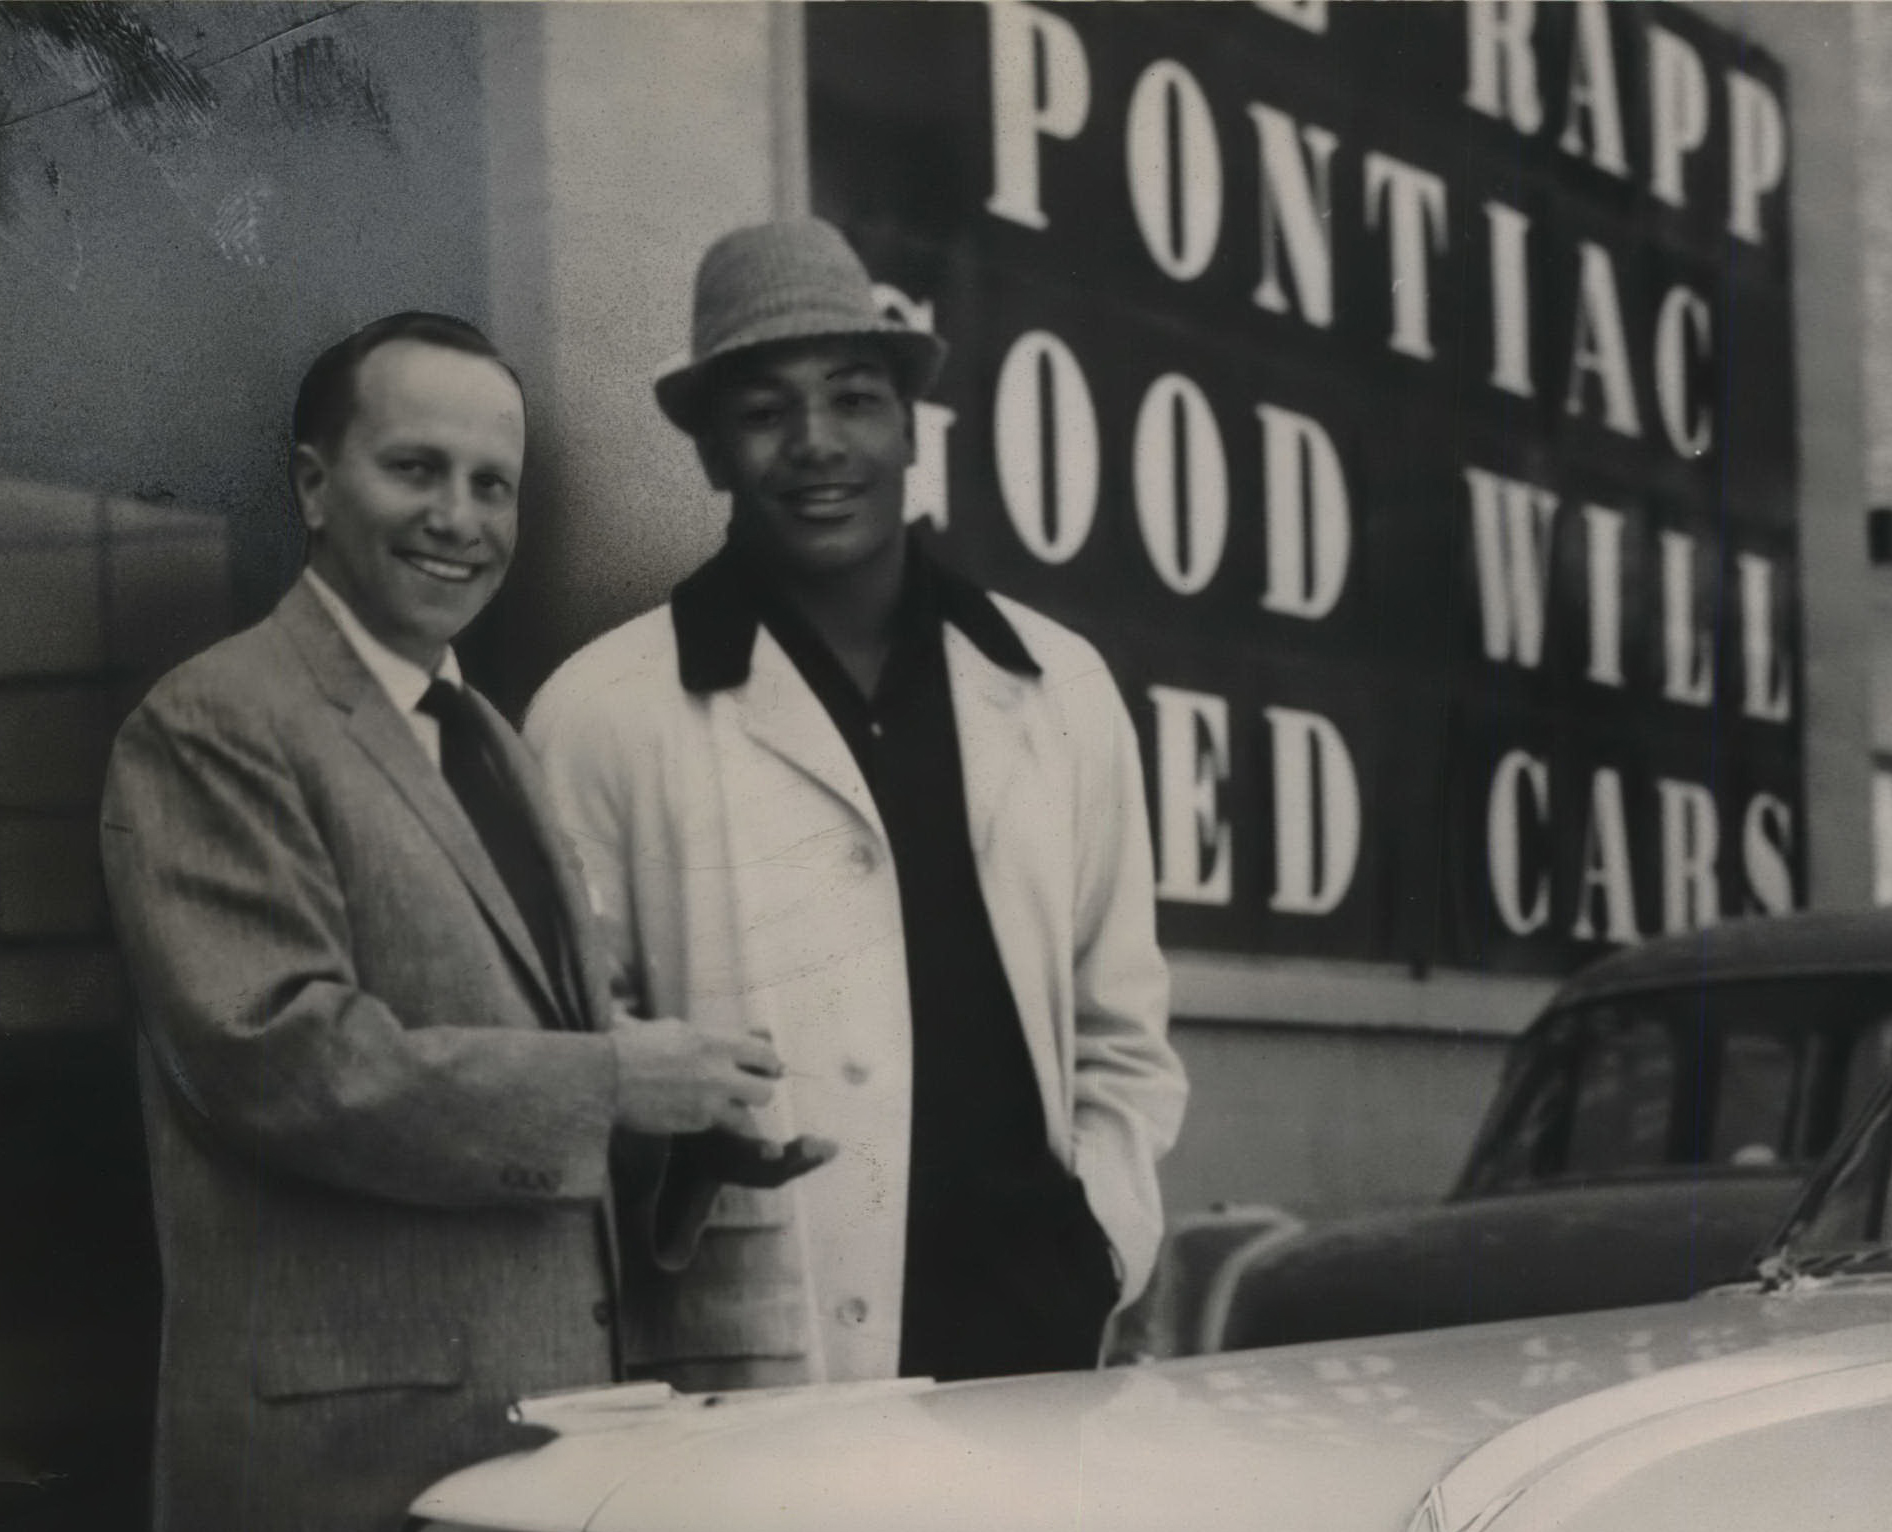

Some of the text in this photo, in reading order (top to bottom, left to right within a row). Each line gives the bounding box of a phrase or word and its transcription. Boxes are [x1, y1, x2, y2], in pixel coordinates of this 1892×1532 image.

[987, 2, 1712, 460] PONTIAC
[1464, 2, 1787, 244] RAPP
[1466, 467, 1790, 722] WILL
[1488, 750, 1796, 947] CARS
